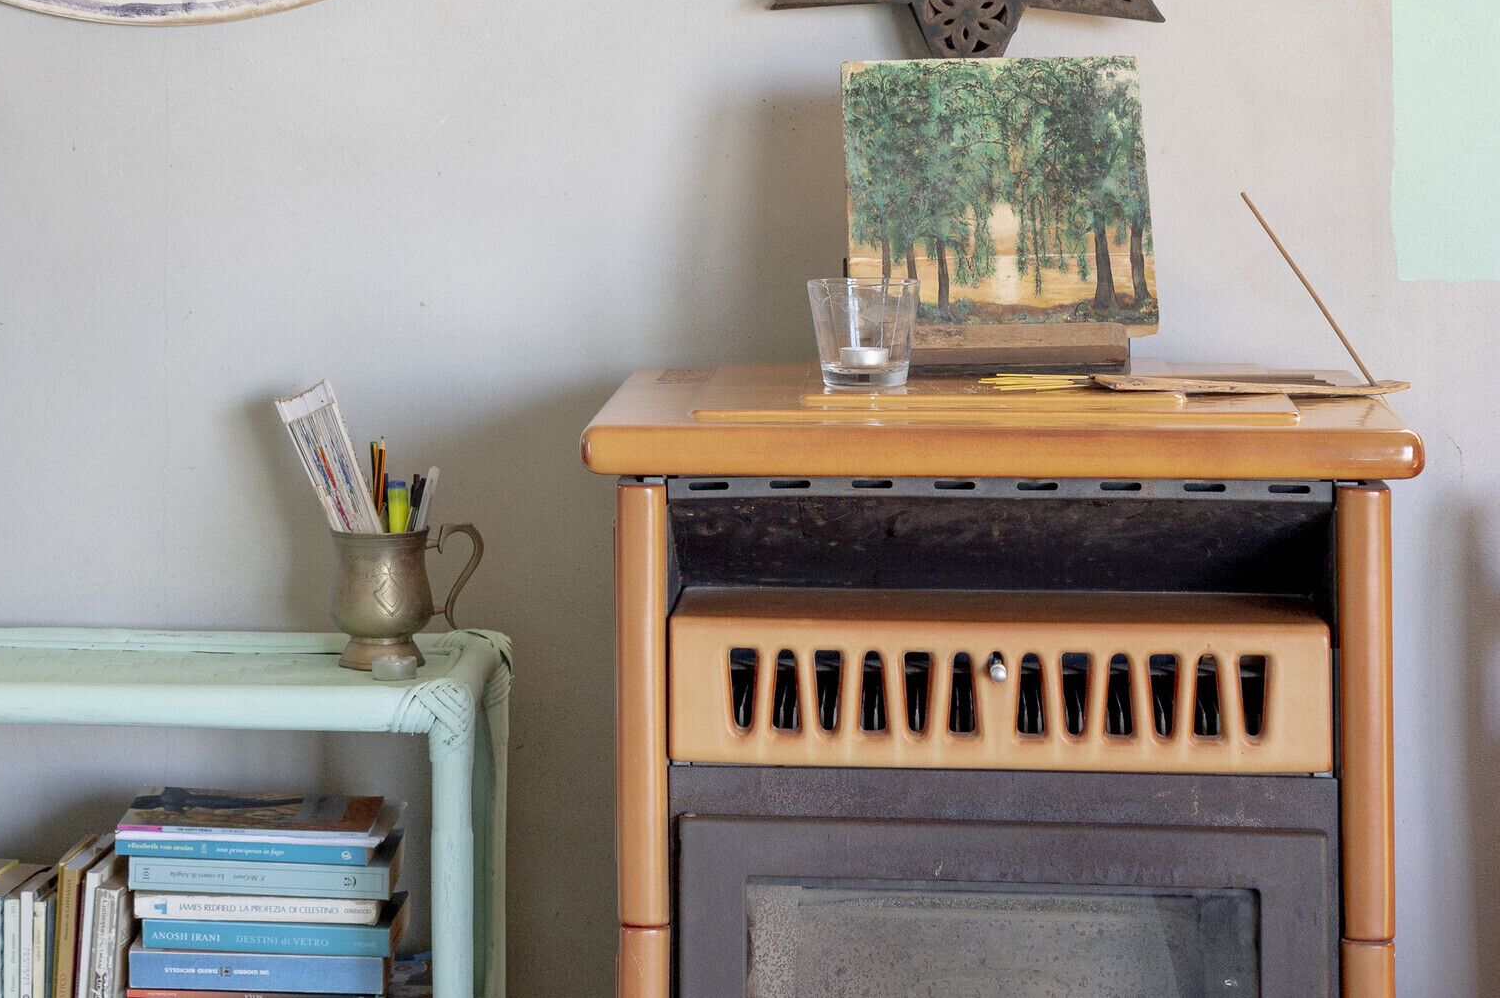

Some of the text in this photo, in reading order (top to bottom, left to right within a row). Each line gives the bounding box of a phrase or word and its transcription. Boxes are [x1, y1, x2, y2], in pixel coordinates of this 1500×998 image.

[179, 903, 202, 912] JAMES
[203, 904, 236, 912] REDFIELD
[239, 904, 249, 912] LA
[250, 905, 286, 913] PROFEZIA
[299, 906, 339, 914] CELESTINO
[151, 931, 329, 947] ANOSH IRANI DESTINI di VETRO
